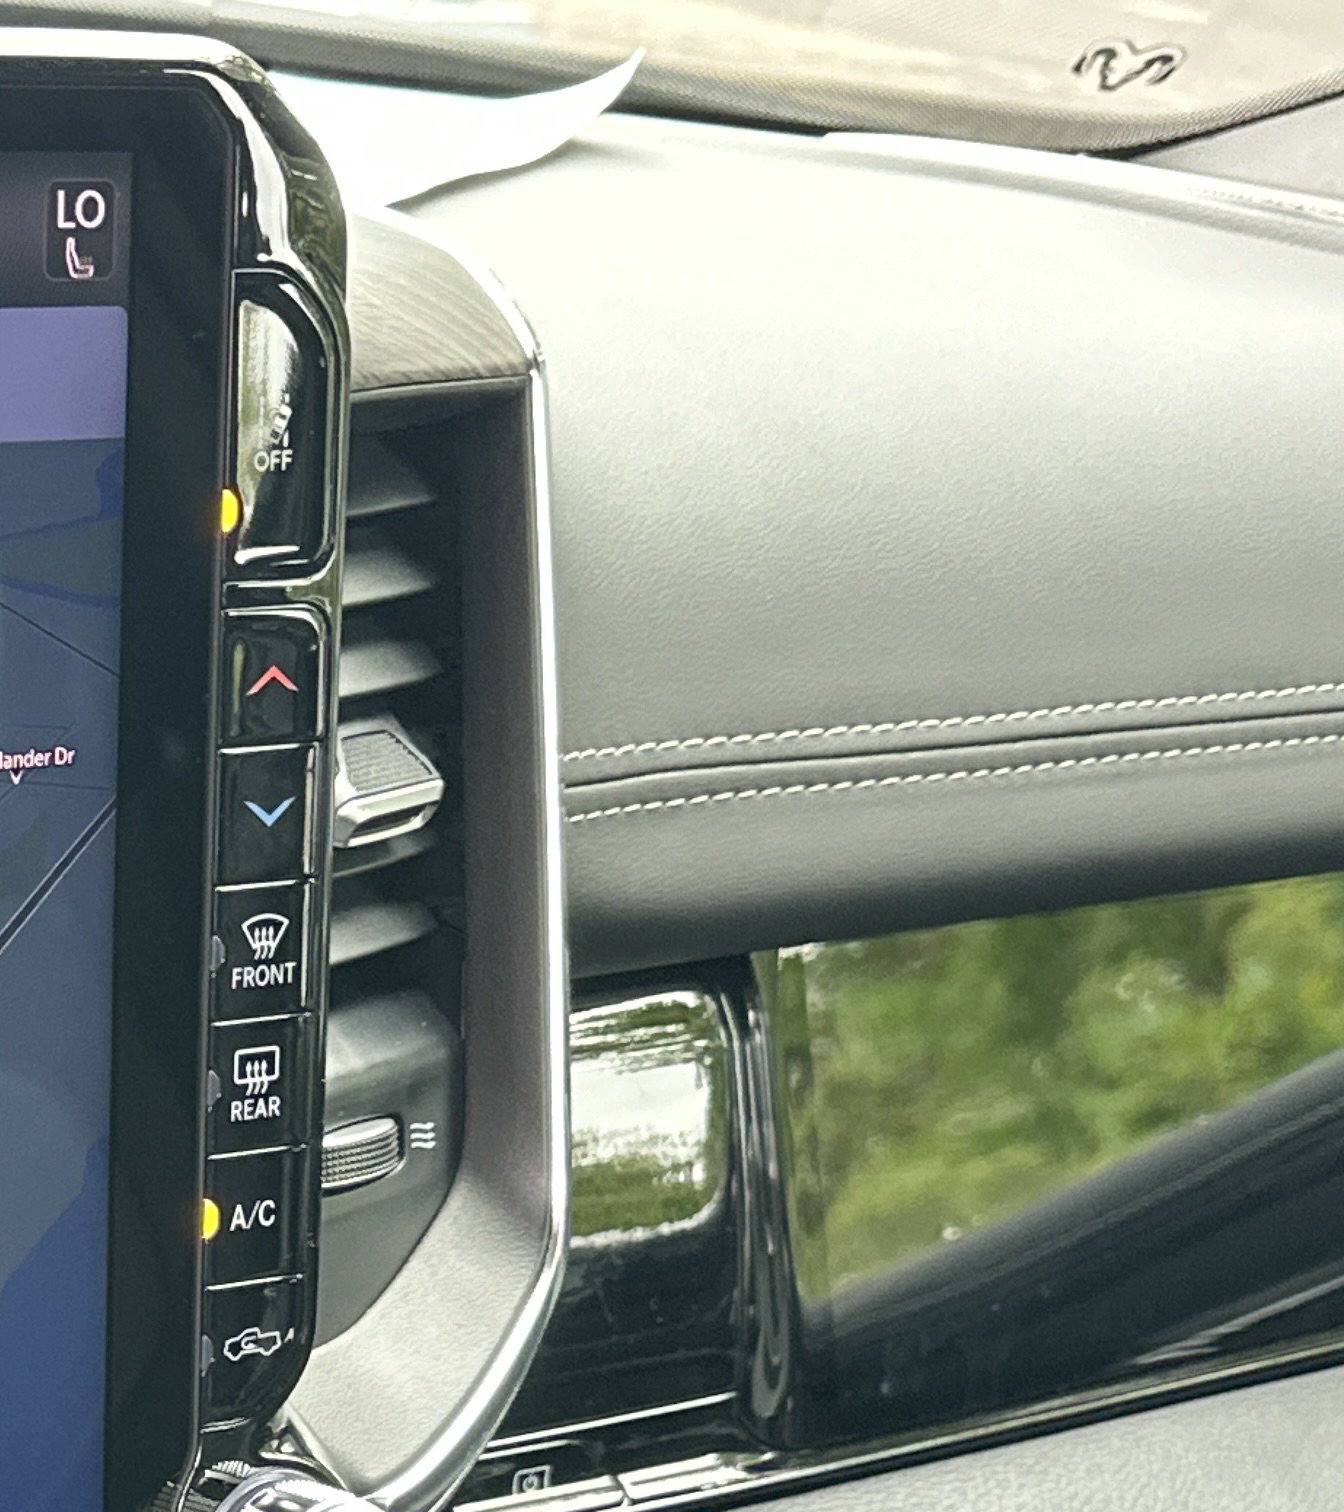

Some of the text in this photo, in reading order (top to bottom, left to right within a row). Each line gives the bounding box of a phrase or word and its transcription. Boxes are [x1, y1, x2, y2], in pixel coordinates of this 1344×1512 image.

[56, 189, 107, 231] LO
[253, 448, 294, 473] OFF
[54, 747, 76, 766] Dr
[231, 961, 296, 990] FRONT
[230, 1096, 281, 1123] REAR
[229, 1199, 277, 1232] A/C
